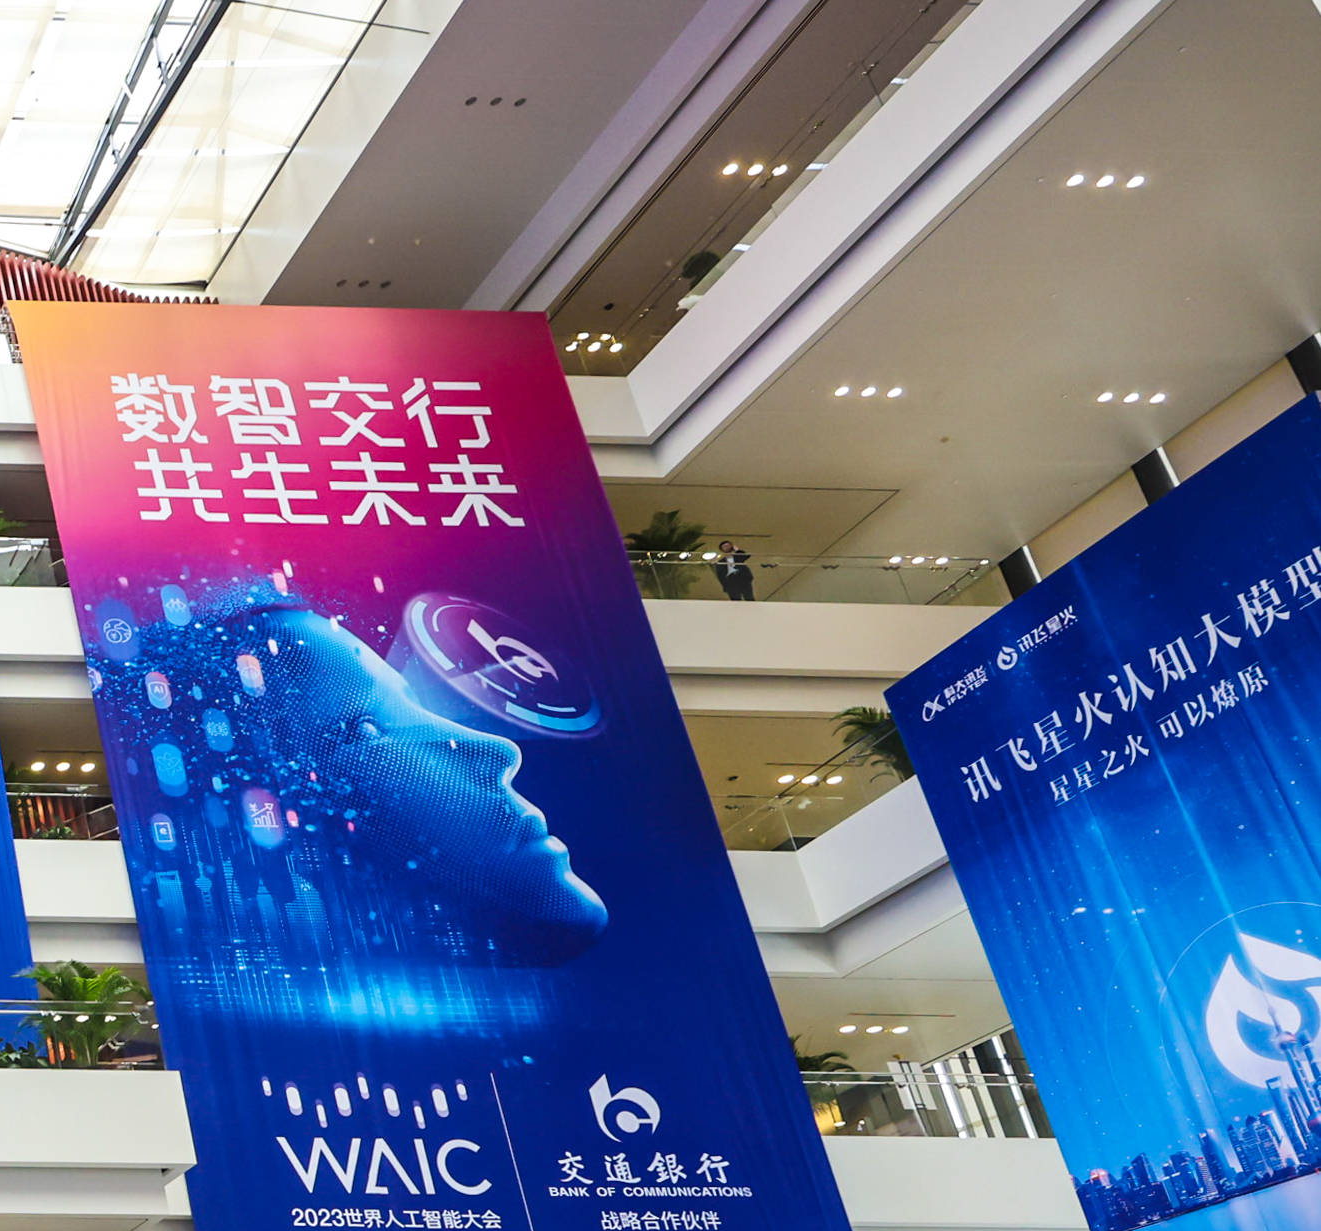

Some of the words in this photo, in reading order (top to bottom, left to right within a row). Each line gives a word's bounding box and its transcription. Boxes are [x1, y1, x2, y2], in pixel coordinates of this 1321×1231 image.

[110, 373, 493, 448] 数智交行
[134, 449, 525, 527] 共生未来
[1016, 605, 1077, 653] 讯飞星火
[961, 546, 1321, 803] 讯飞星火认知大模型
[1049, 734, 1150, 807] 星星之火
[1157, 664, 1269, 742] 可以燎原
[276, 1136, 493, 1196] WAIC
[548, 1187, 590, 1197] BANK
[596, 1187, 616, 1197] OF
[623, 1187, 753, 1197] COMMUNICATIONS
[292, 1208, 502, 1231] 2023世界人工智能大会
[601, 1211, 722, 1231] 战略合作伙伴
